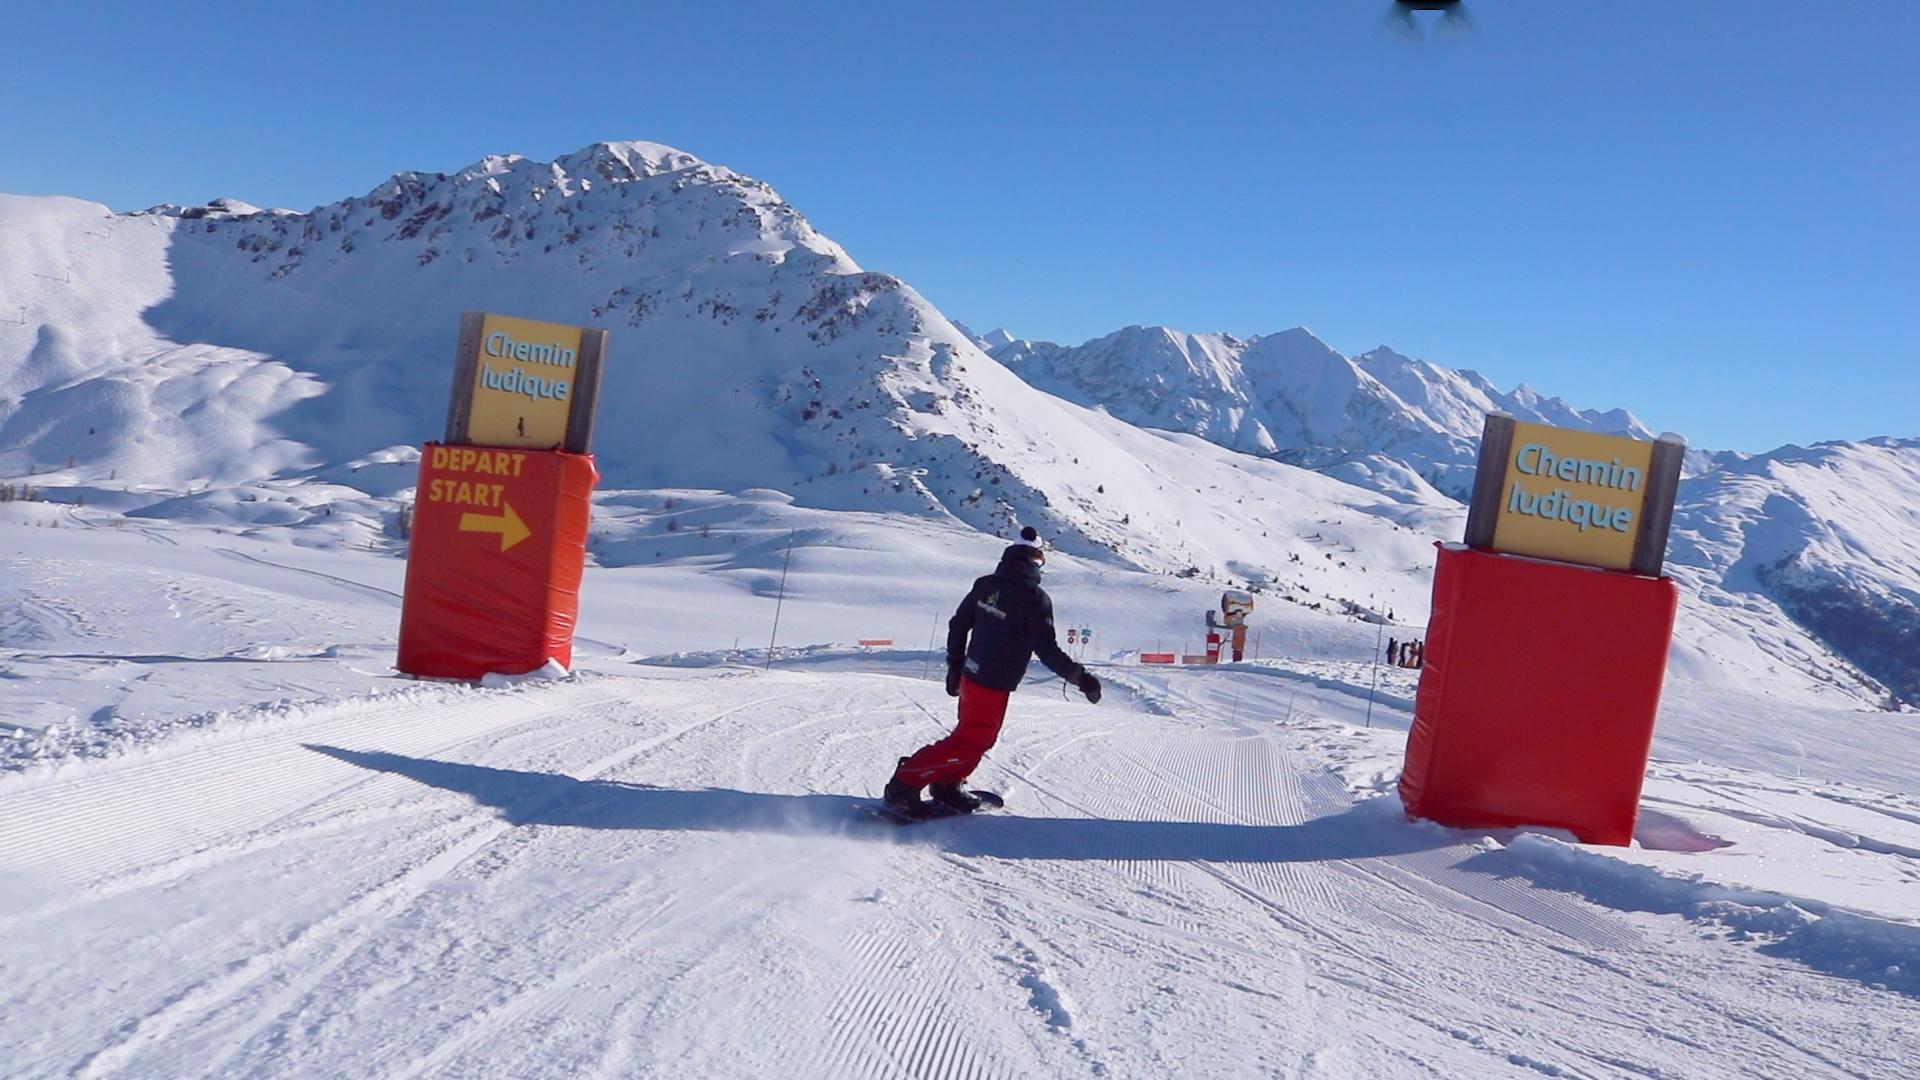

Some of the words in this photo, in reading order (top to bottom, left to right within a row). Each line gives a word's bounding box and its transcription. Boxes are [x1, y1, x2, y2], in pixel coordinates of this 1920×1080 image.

[485, 331, 575, 368] Chemin
[480, 364, 568, 401] ludique
[432, 447, 526, 477] DEPART
[1515, 443, 1642, 492] Chemin
[429, 479, 504, 507] START
[1507, 481, 1633, 533] ludique
